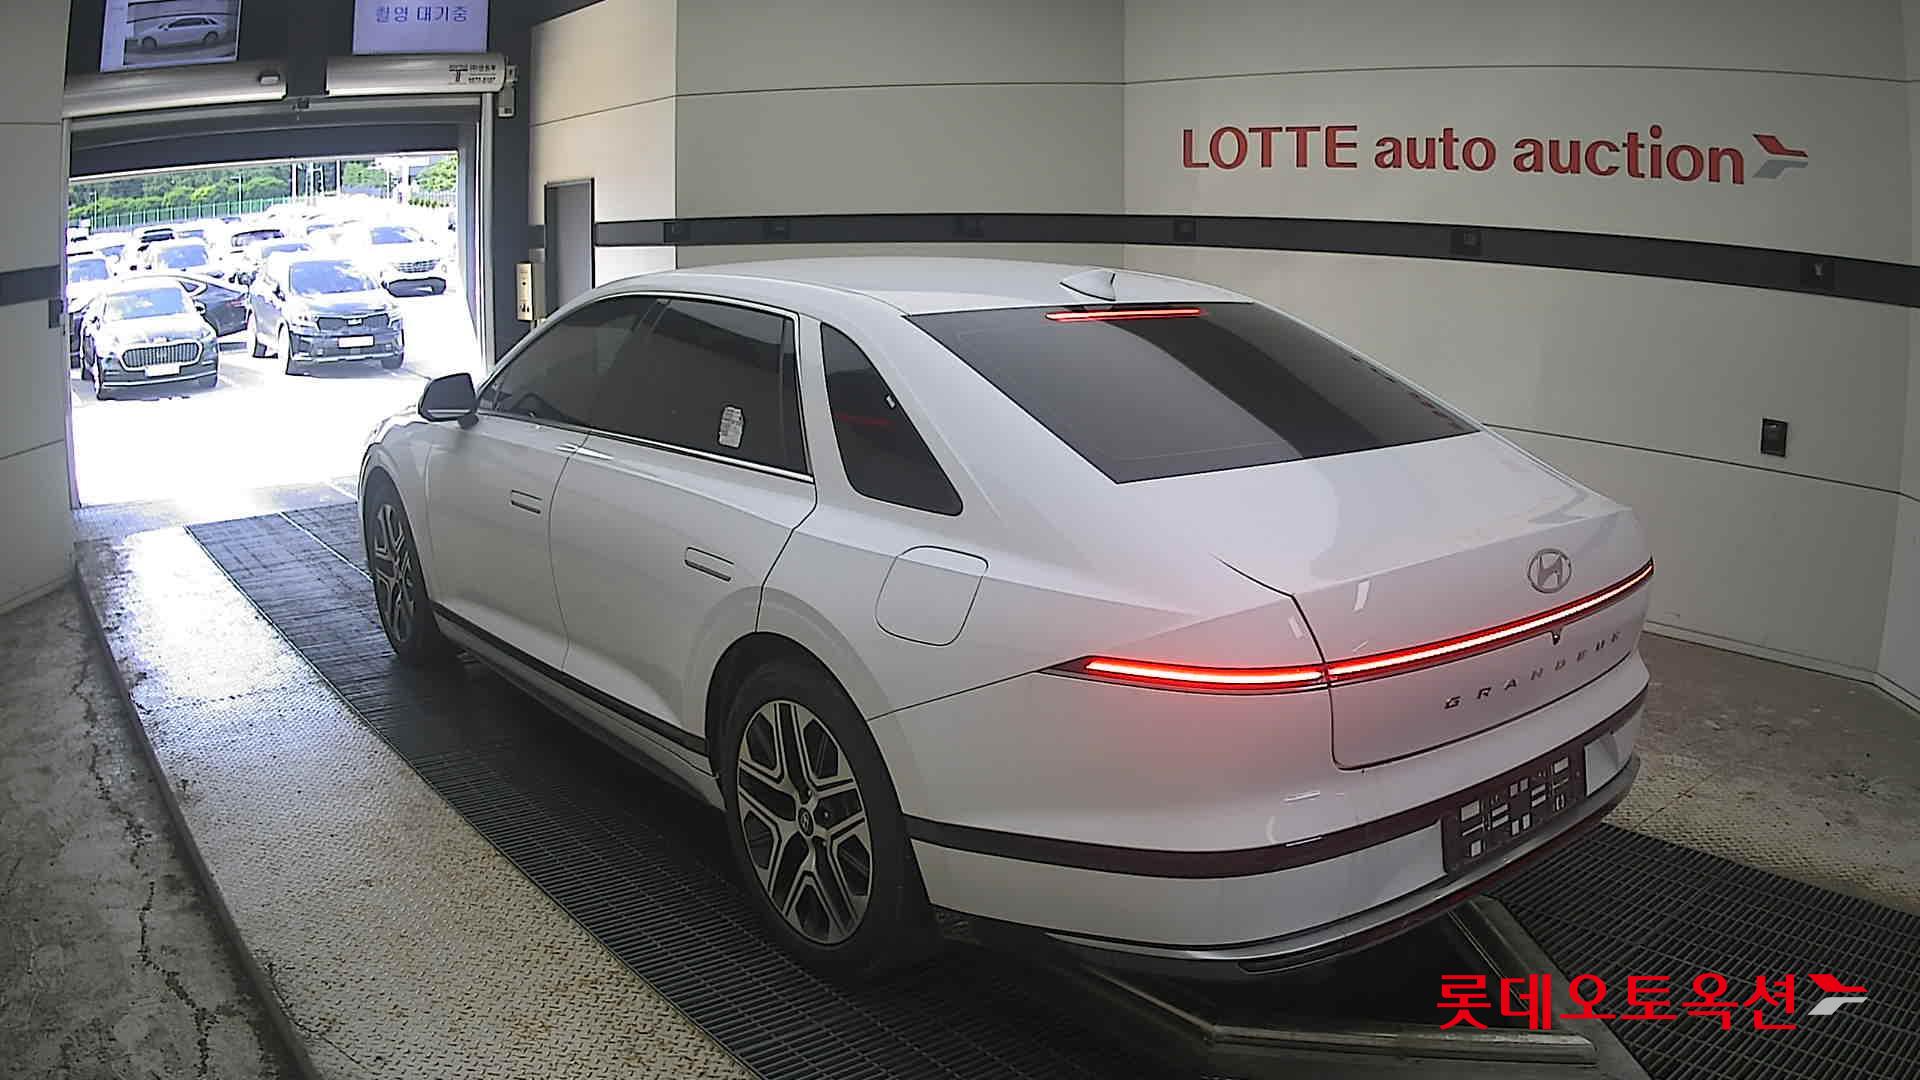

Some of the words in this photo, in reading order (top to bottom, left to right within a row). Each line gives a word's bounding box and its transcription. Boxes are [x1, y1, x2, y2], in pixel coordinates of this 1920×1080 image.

[416, 6, 468, 22] 대기중
[1183, 125, 1358, 169] LOTTE
[1374, 128, 1497, 172] auto
[1513, 124, 1745, 185] auction
